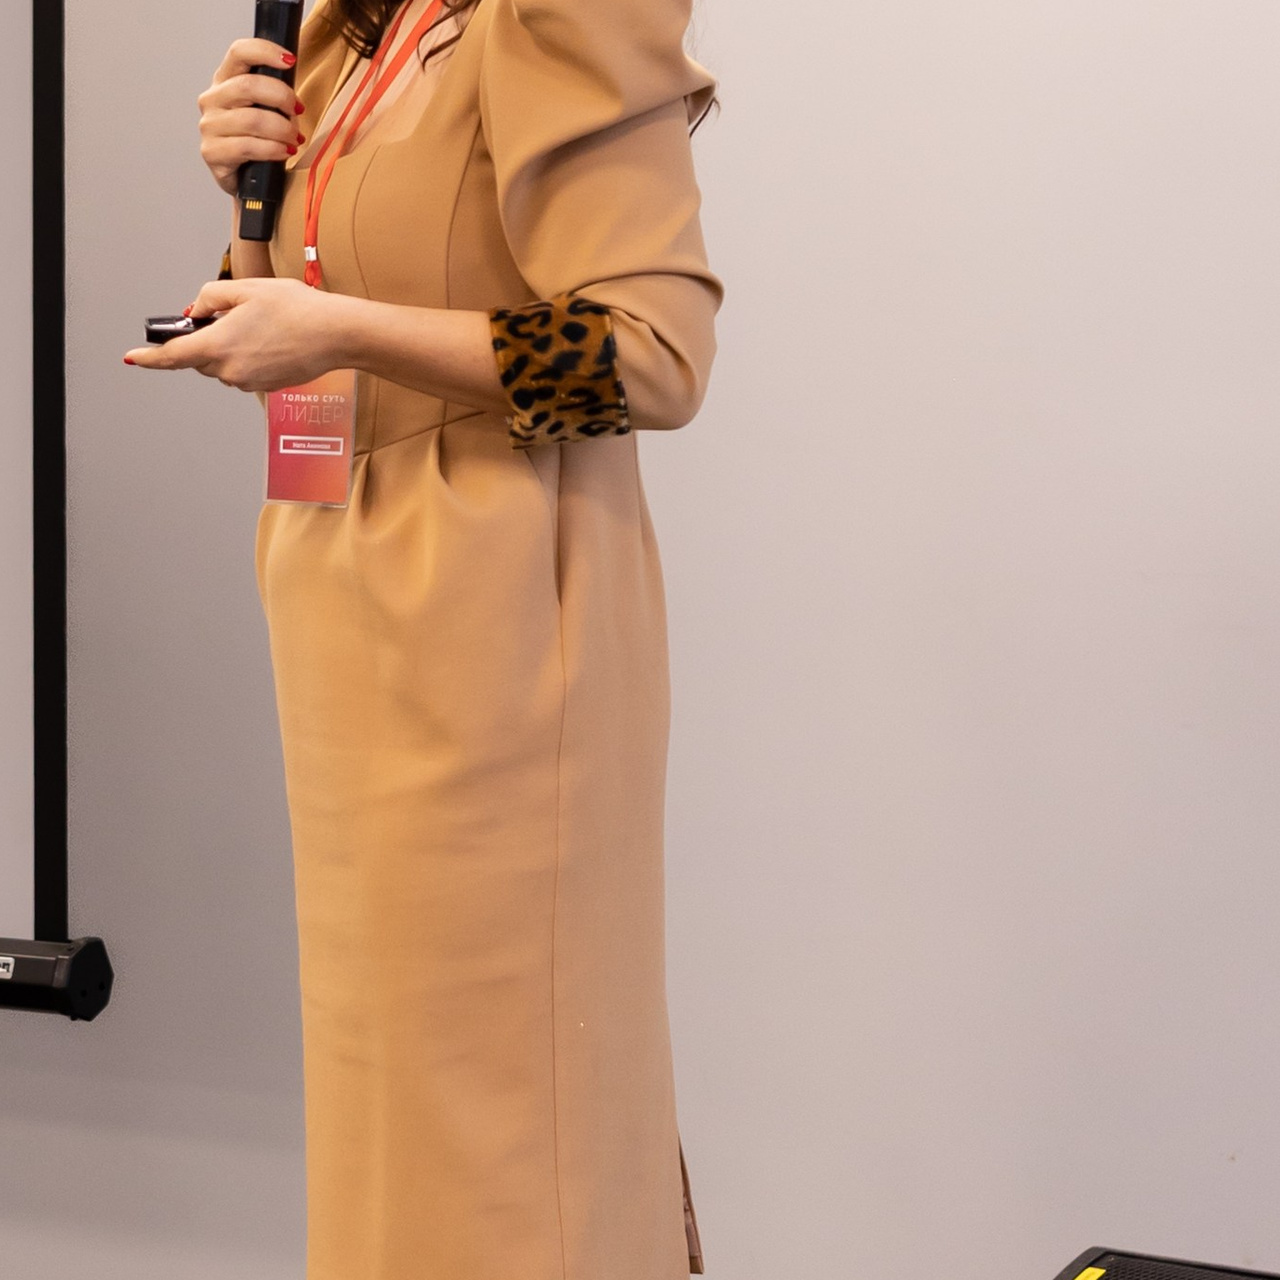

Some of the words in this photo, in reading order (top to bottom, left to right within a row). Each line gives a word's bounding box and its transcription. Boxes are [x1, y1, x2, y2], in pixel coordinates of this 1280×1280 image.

[281, 393, 320, 402] ТОЛЬКО
[322, 394, 345, 403] СУТЬ
[280, 404, 344, 425] ЛИДЕР
